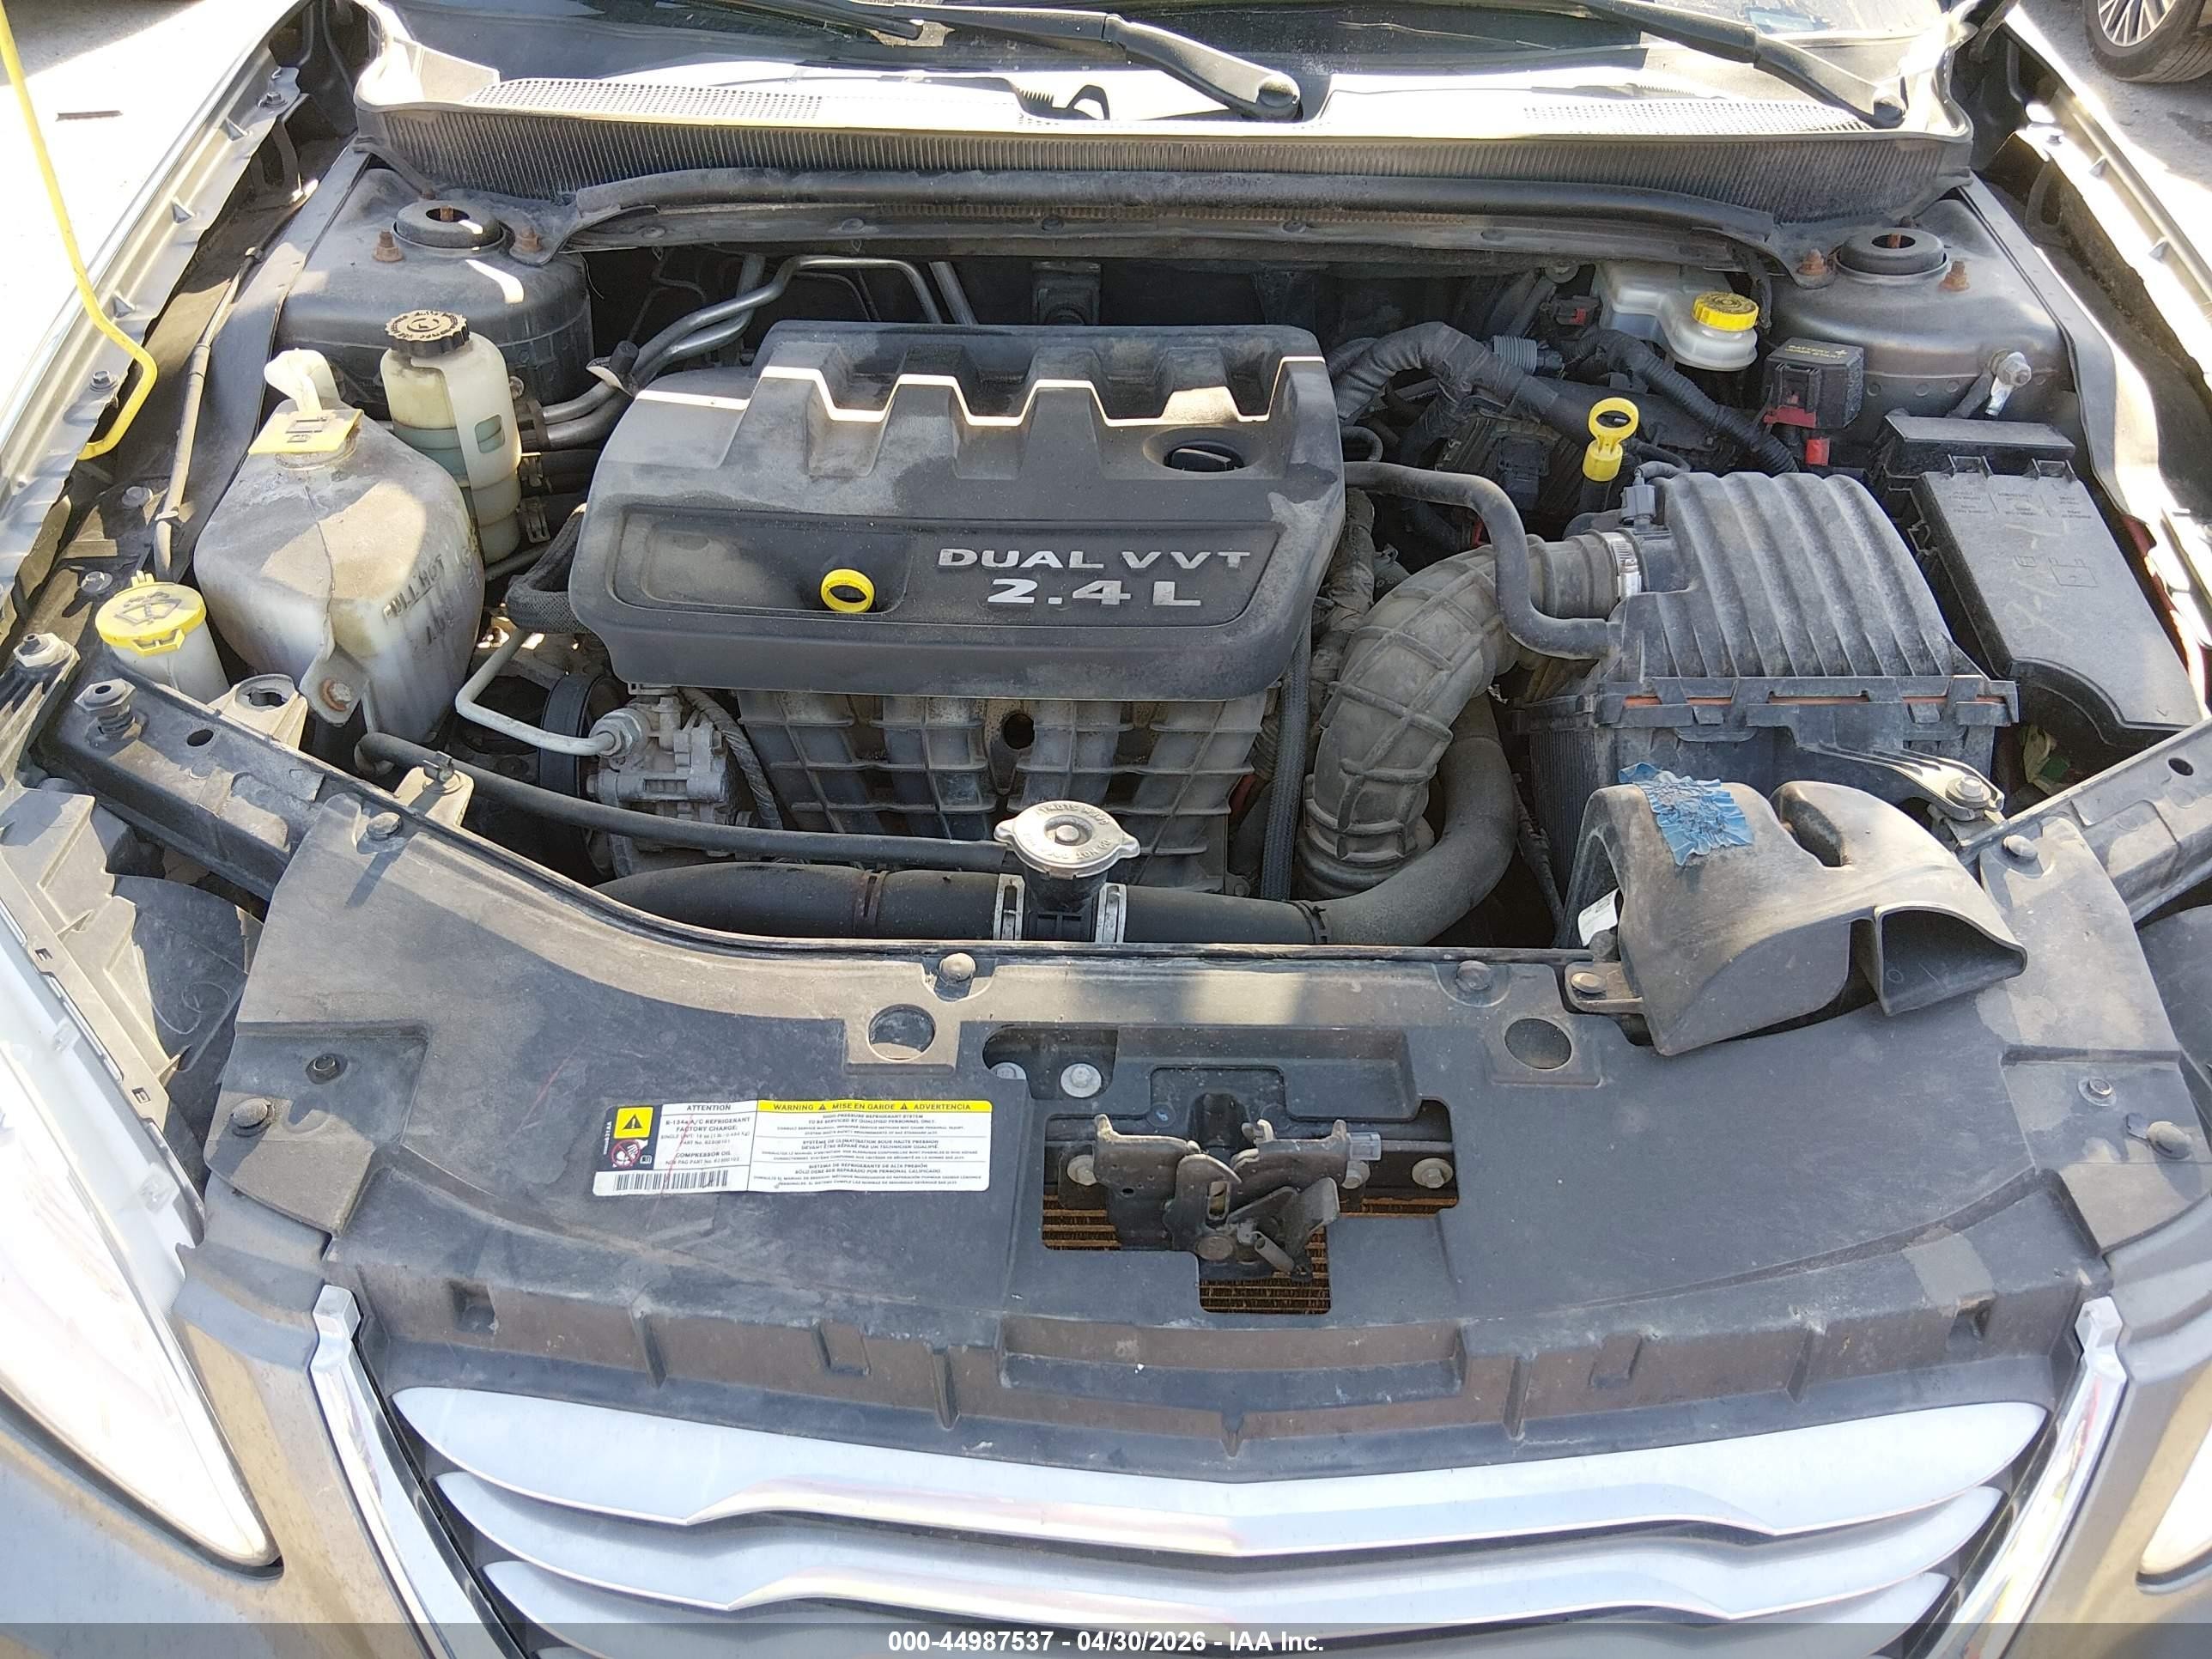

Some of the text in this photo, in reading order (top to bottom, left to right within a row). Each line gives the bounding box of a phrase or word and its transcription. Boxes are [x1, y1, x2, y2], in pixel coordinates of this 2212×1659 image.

[419, 554, 445, 586] HOT
[937, 548, 1251, 570] DUAL VVT
